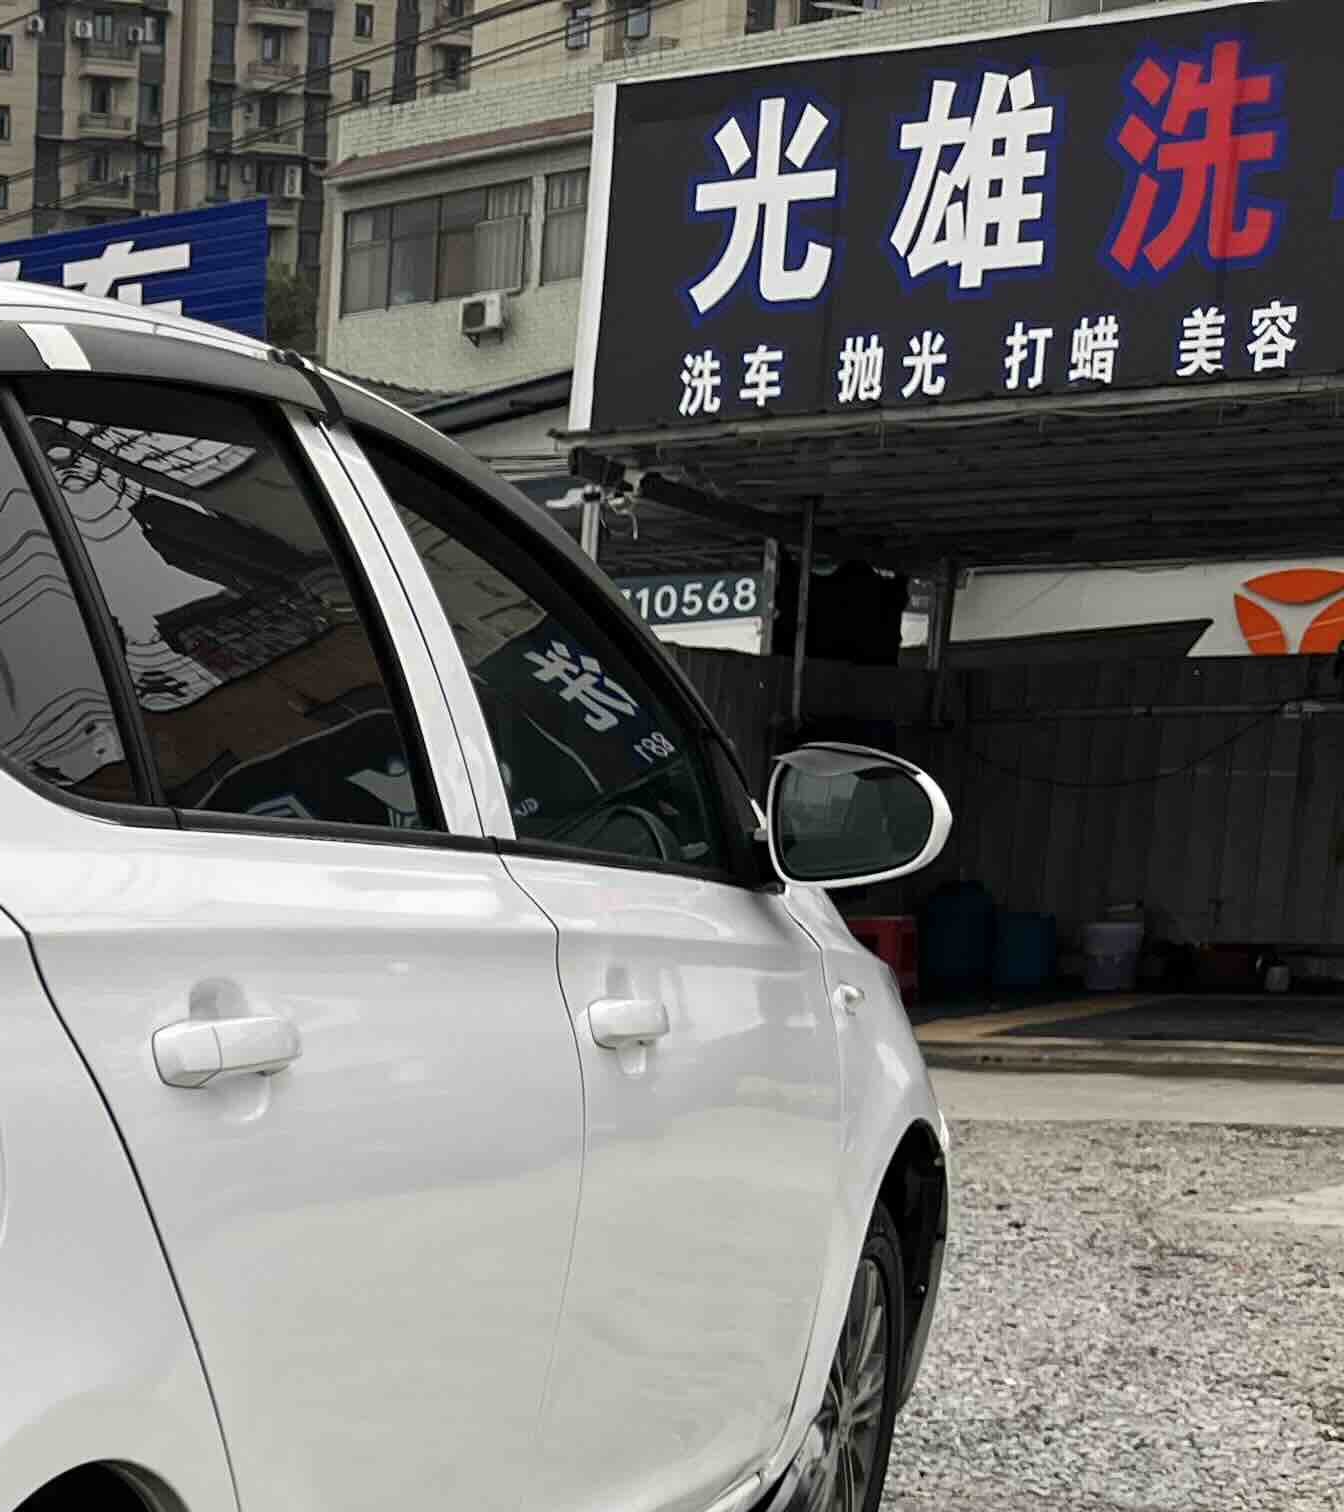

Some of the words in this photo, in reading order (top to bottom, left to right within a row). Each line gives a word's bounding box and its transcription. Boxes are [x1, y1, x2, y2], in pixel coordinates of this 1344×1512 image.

[689, 40, 1275, 314] 光雄洗
[679, 345, 784, 415] 洗车
[837, 329, 948, 402] 抛光
[1004, 314, 1120, 390] 打蜡
[1176, 300, 1299, 378] 美容
[619, 577, 758, 620] 10568
